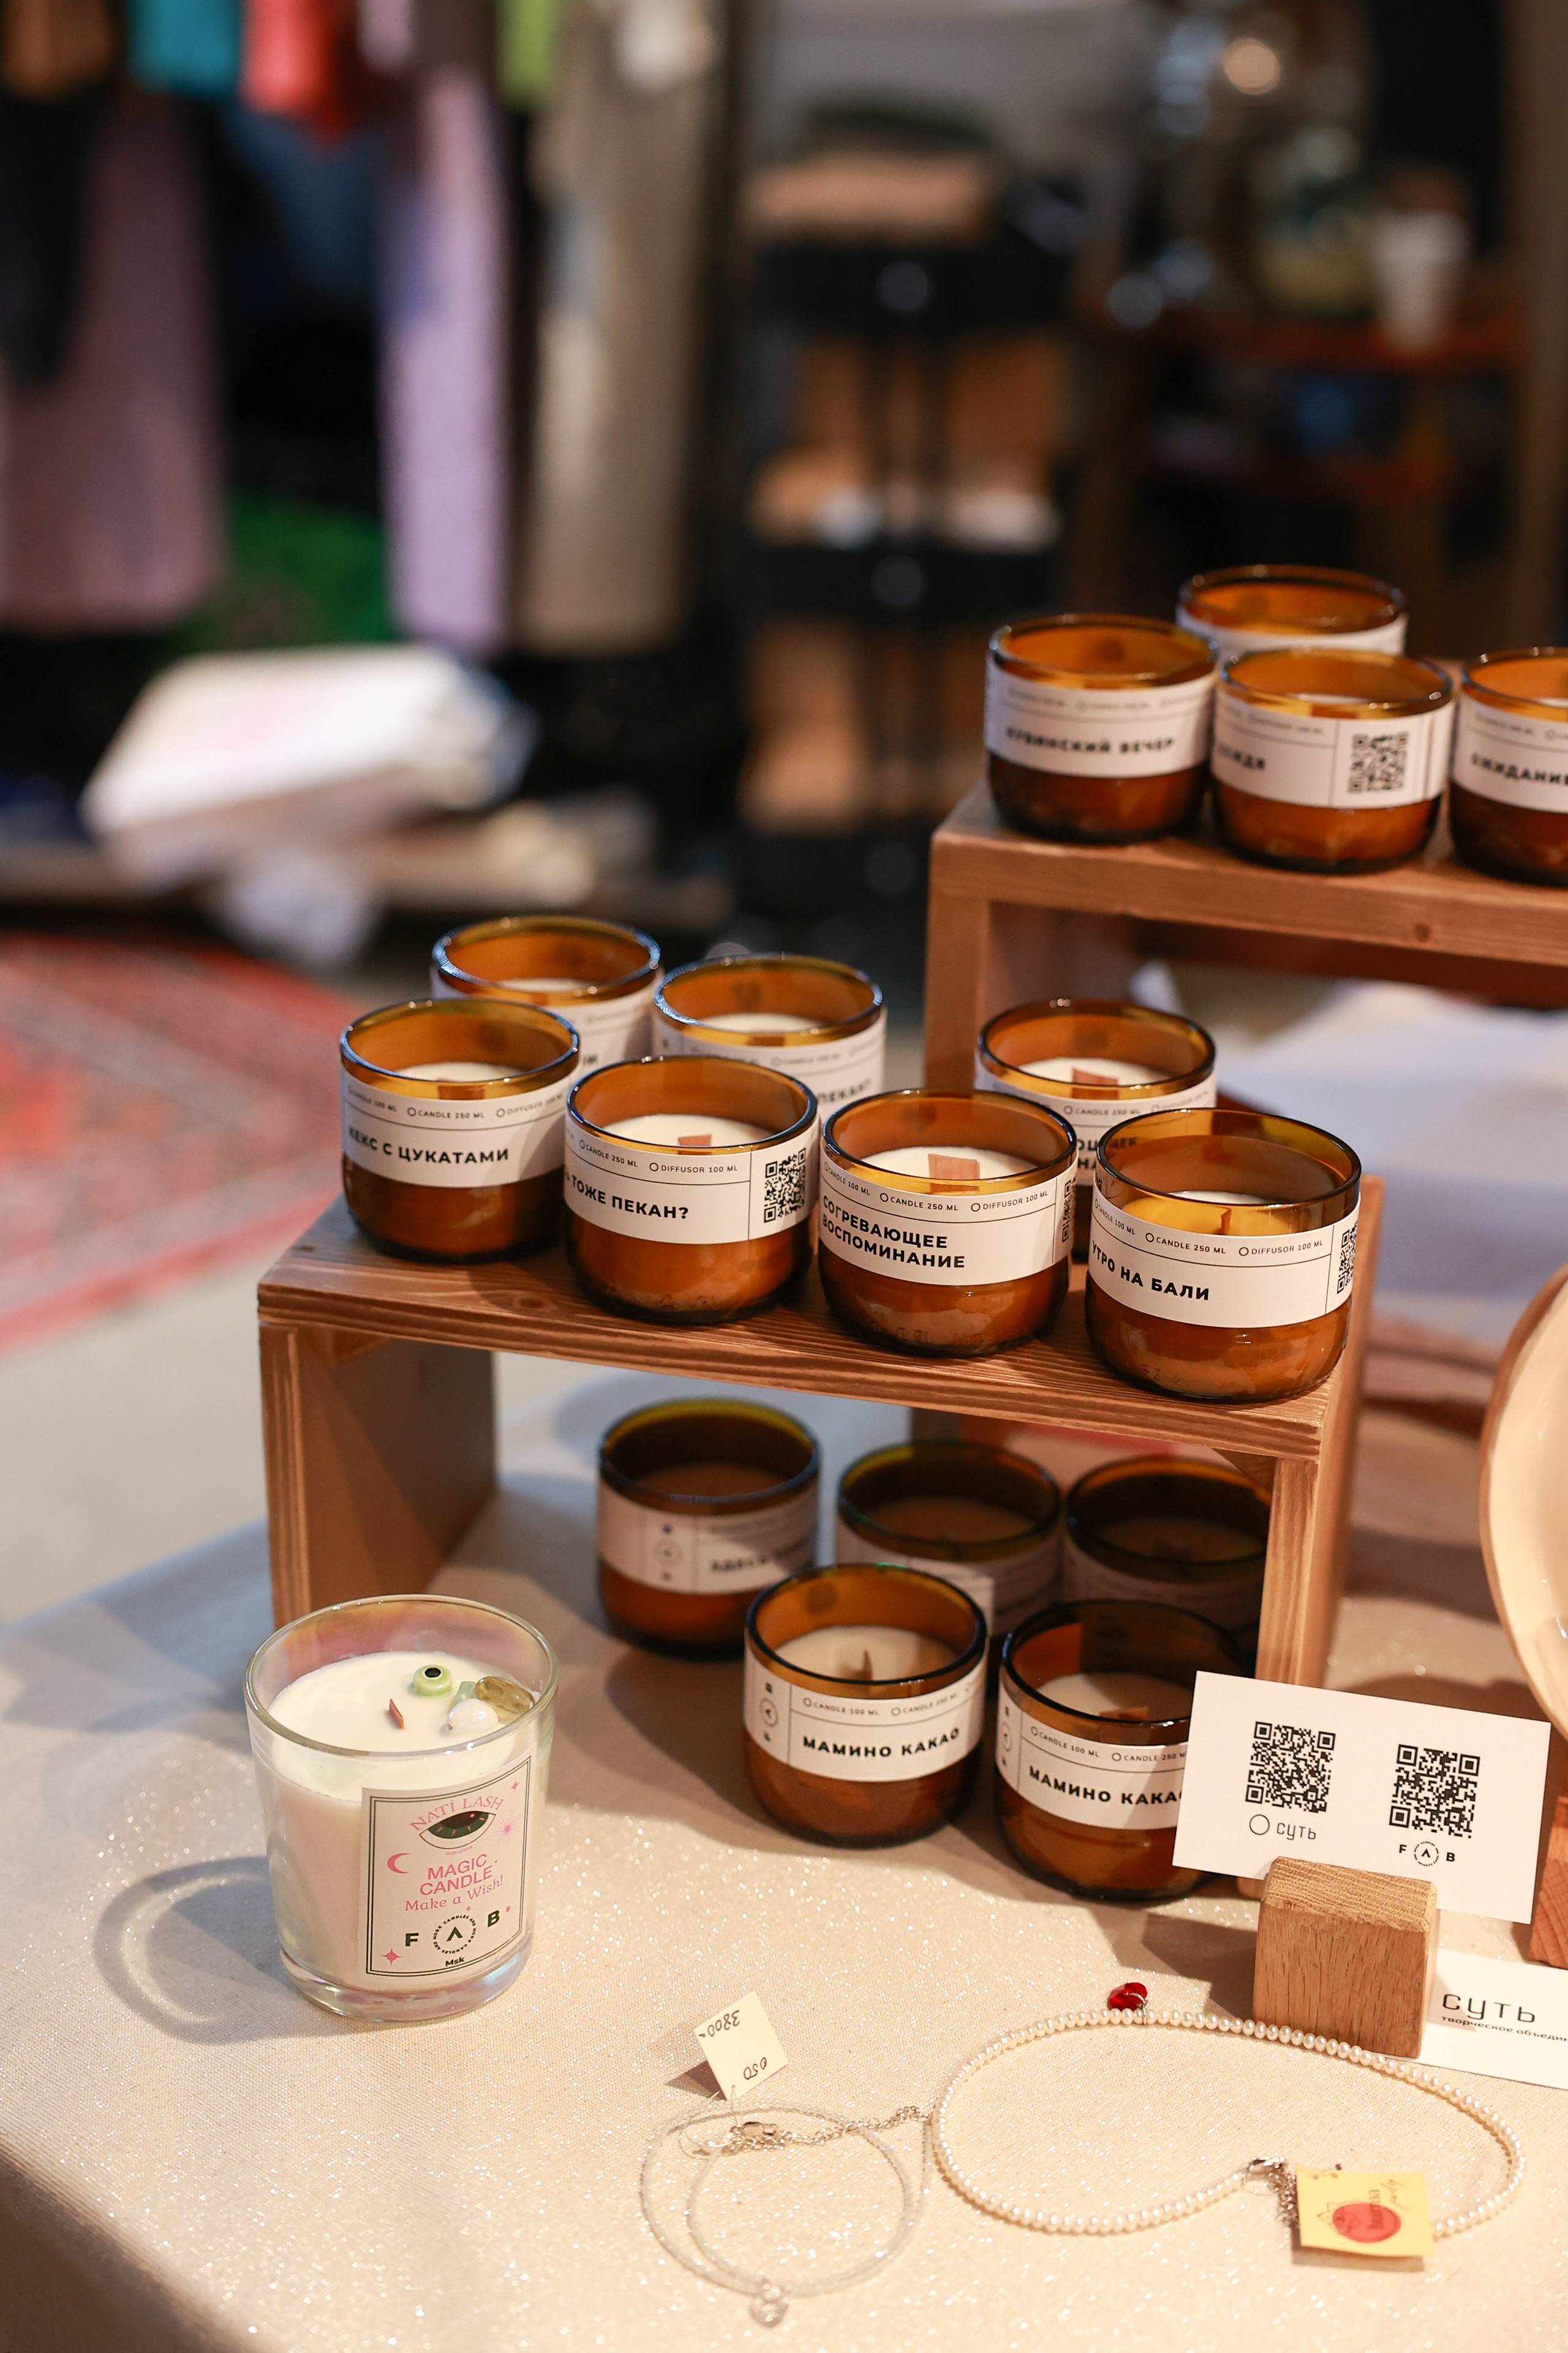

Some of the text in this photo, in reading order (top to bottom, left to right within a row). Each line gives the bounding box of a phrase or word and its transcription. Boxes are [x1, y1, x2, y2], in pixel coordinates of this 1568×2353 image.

[418, 1110, 451, 1119] CANDLE
[383, 1143, 393, 1155] С
[398, 1146, 509, 1164] ЦУКАТАМИ
[586, 1144, 609, 1160] CANDLE
[612, 1155, 625, 1165] 250
[661, 1165, 705, 1174] DIFFUSOR
[828, 1167, 870, 1196] CANDLE 100 ML
[572, 1174, 689, 1220] ТОЖЕ ПЕКАН?
[891, 1196, 924, 1209] CANDLE
[983, 1198, 1023, 1210] DIFFUSOR
[1026, 1194, 1038, 1203] 100
[823, 1195, 948, 1248] СОГРЕВАЮЩЕЕ
[1098, 1204, 1136, 1236] CANDLE 100 ML
[823, 1214, 965, 1268] ВОСПОМИНАНИЕ
[1156, 1236, 1190, 1250] CANDLE
[1251, 1245, 1295, 1255] DIFFUSOR
[1298, 1242, 1311, 1251] 100
[1092, 1240, 1210, 1301] УТРО НА БАЛИ
[813, 1702, 846, 1713] CANDLE
[903, 1702, 933, 1713] CANDLE
[802, 1727, 960, 1758] МАМИНО КАКАО
[1039, 1732, 1068, 1749] CANDLE
[1071, 1745, 1085, 1754] 100
[1162, 1753, 1177, 1761] 250
[1029, 1764, 1182, 1805] МАМИНО КАКА
[462, 1796, 505, 1811] LASH
[428, 1853, 488, 1880] MAGIC
[420, 1865, 493, 1895] CANDLE
[404, 1874, 503, 1911] Make a Wish!
[1441, 2016, 1513, 2033] творческое
